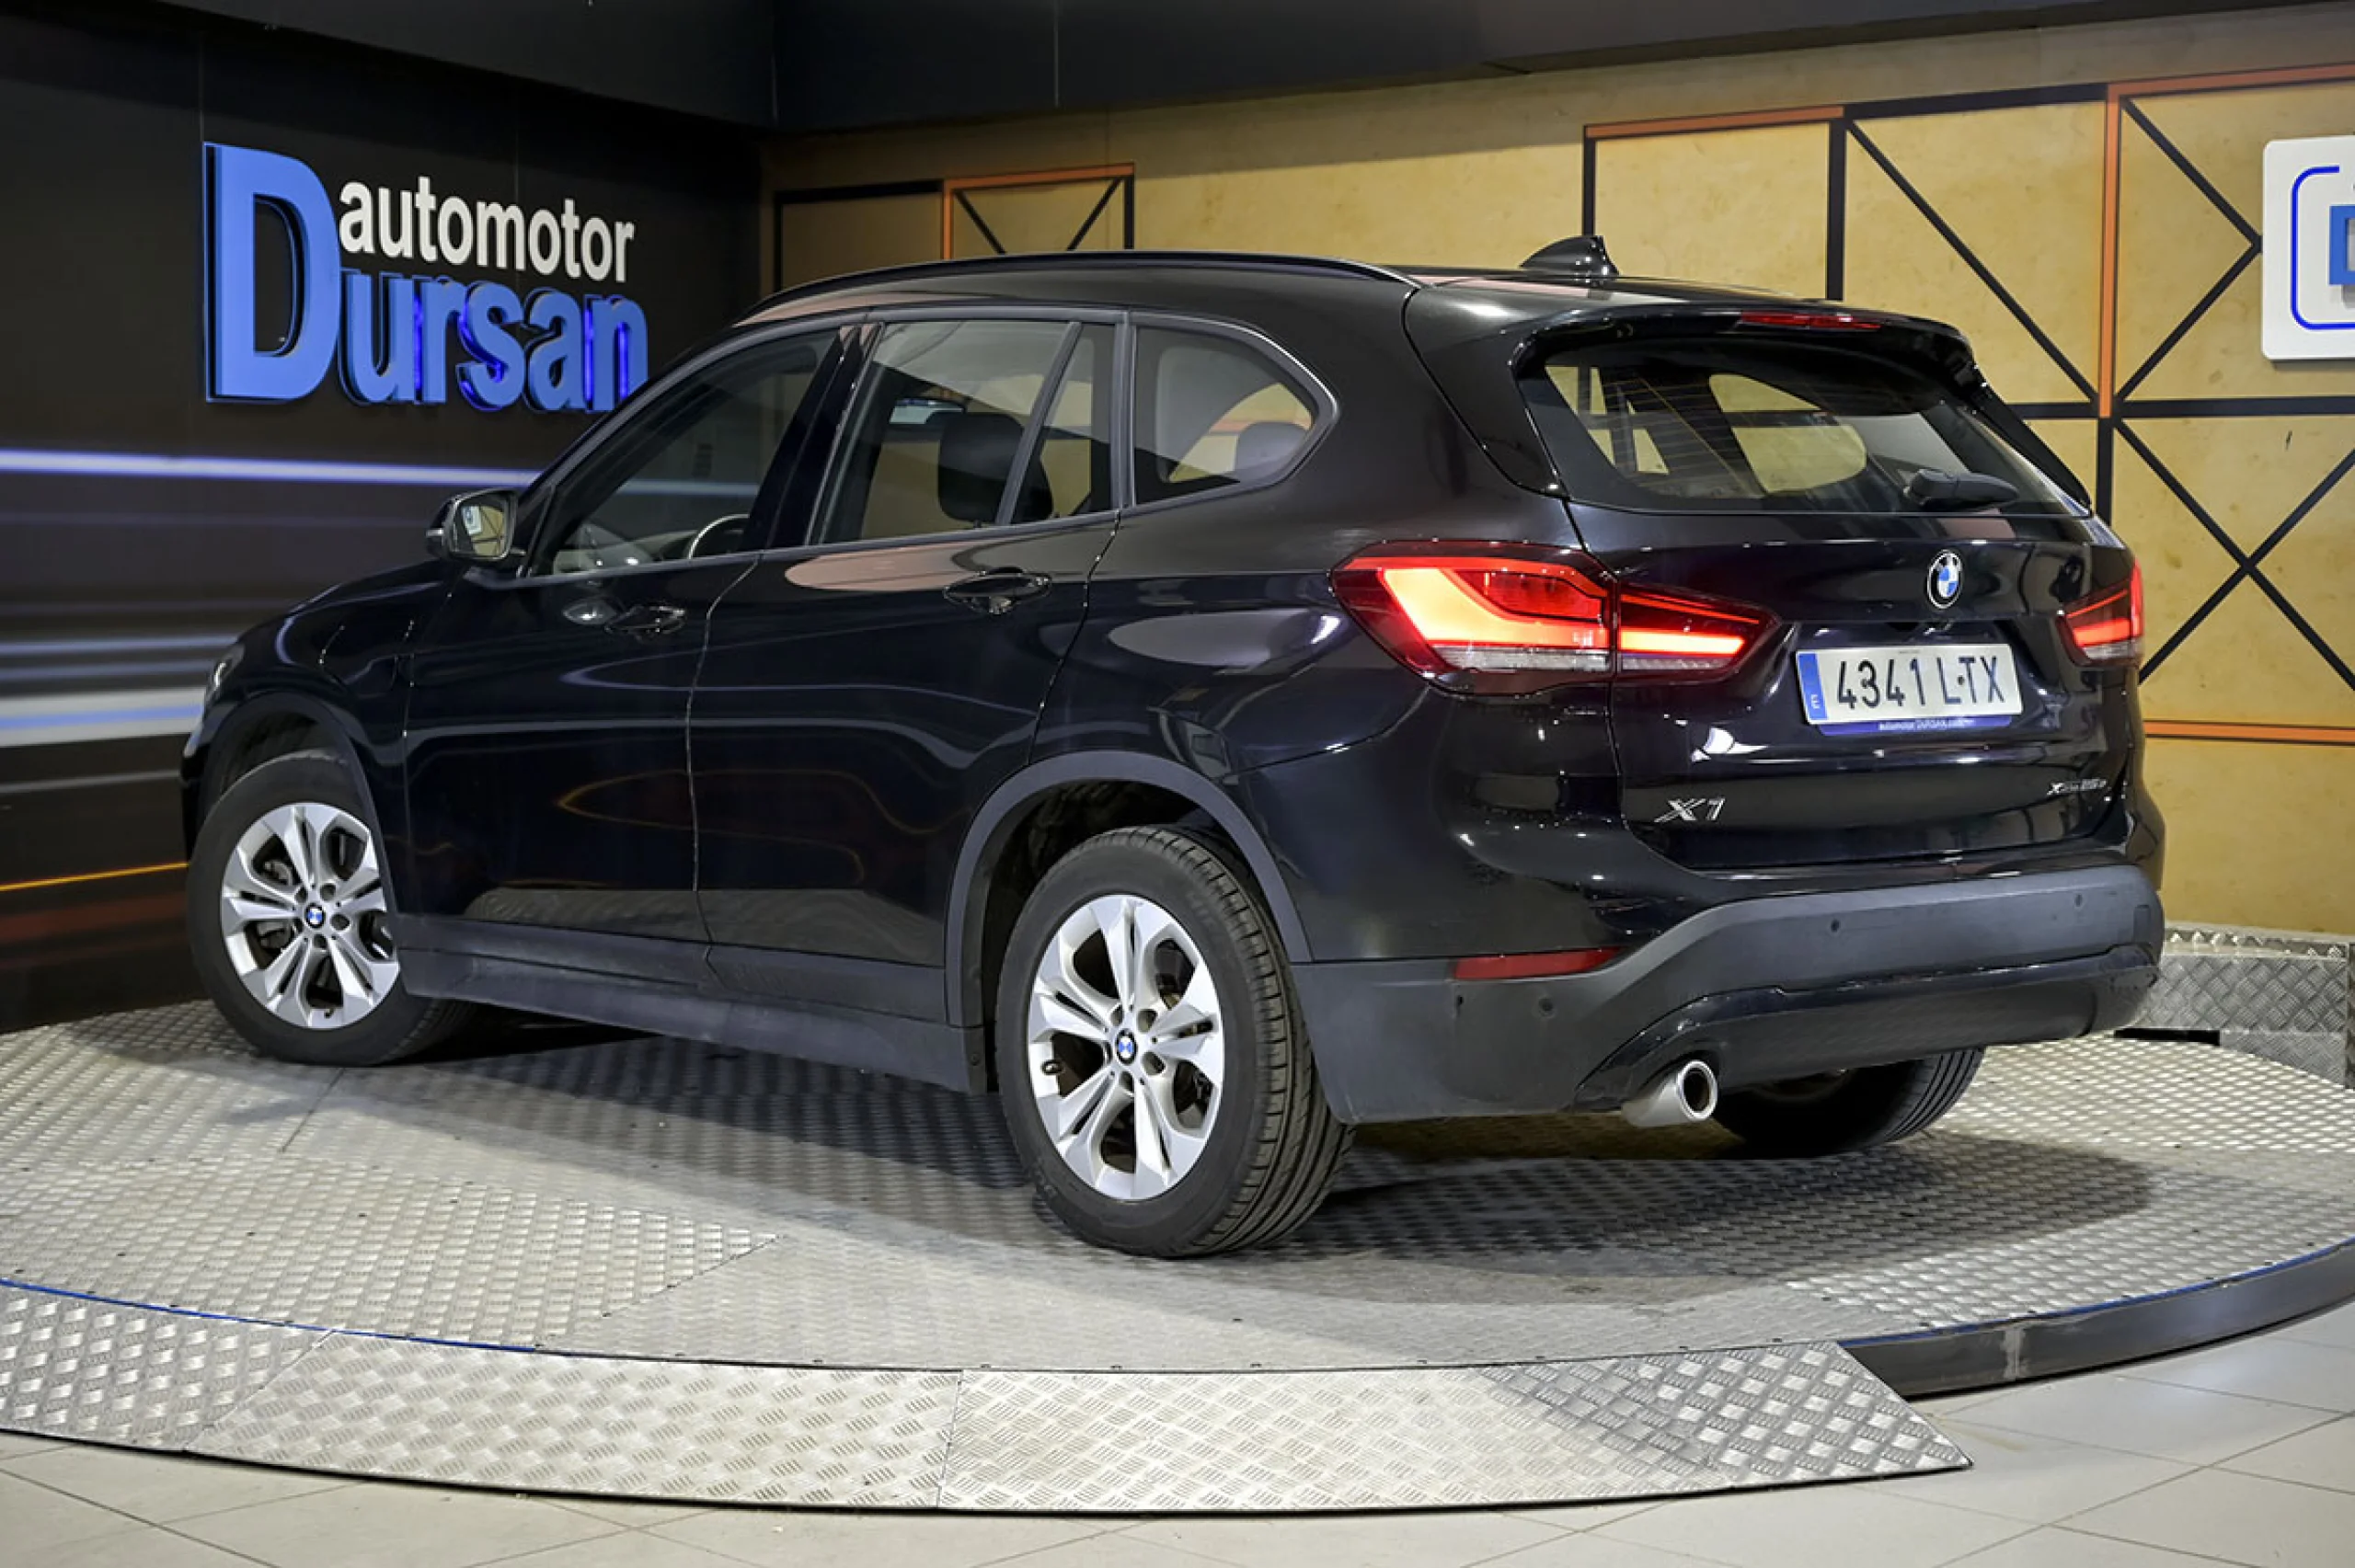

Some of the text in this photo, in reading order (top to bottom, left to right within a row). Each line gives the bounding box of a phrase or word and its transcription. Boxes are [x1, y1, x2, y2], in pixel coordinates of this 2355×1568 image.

[339, 176, 636, 282] automotor
[203, 142, 648, 412] Dursan
[1837, 658, 1925, 709] 4341
[1936, 657, 2005, 704] LTX
[1654, 797, 1726, 822] X1
